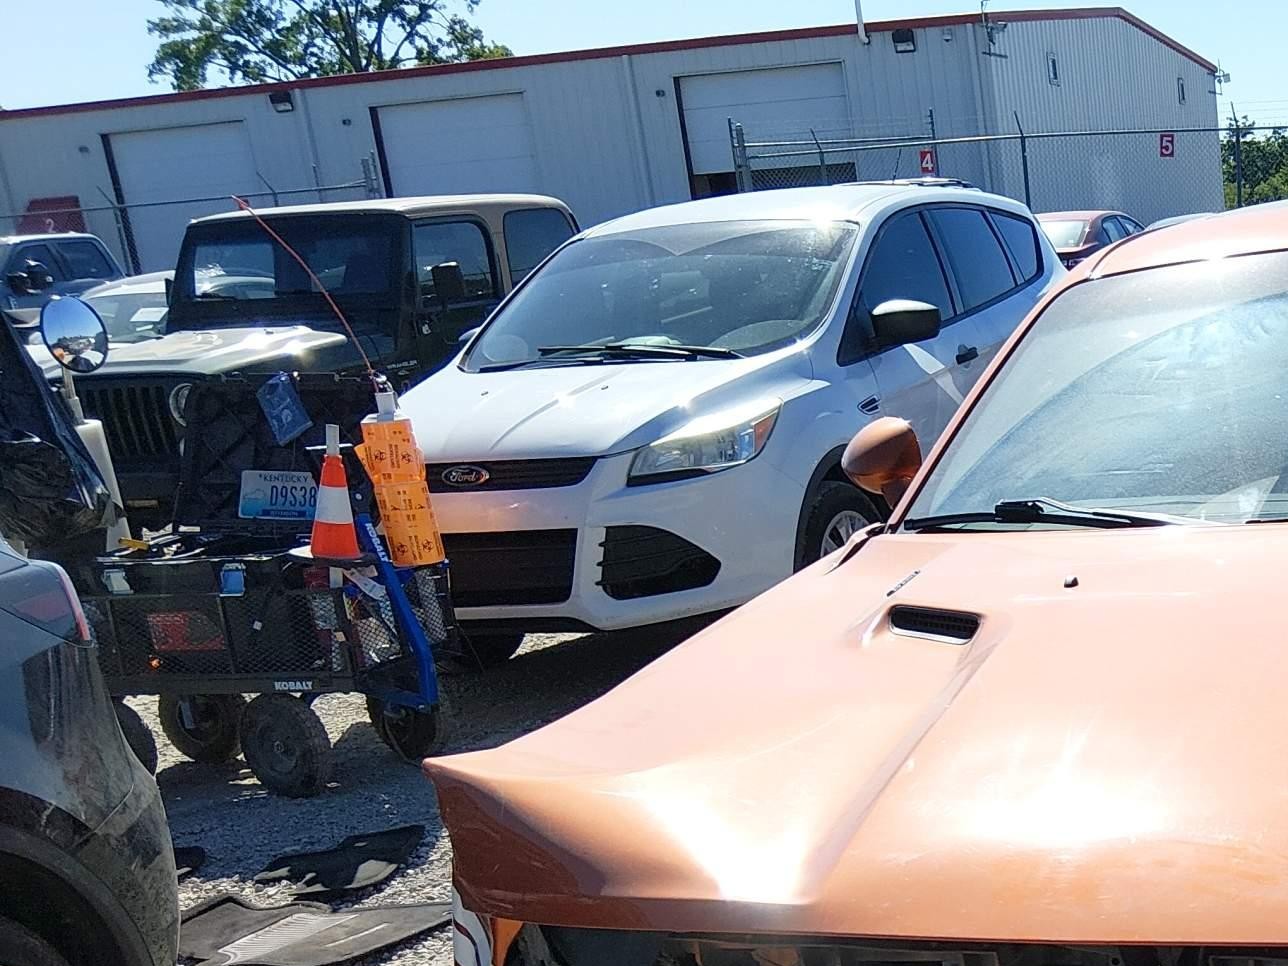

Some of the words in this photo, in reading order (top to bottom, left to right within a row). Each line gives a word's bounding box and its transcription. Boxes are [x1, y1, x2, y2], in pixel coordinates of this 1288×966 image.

[1162, 136, 1173, 155] 5
[921, 152, 934, 171] 4
[264, 473, 309, 483] KENTUCKY
[365, 522, 390, 563] KOBALT
[274, 681, 313, 690] KOBALT
